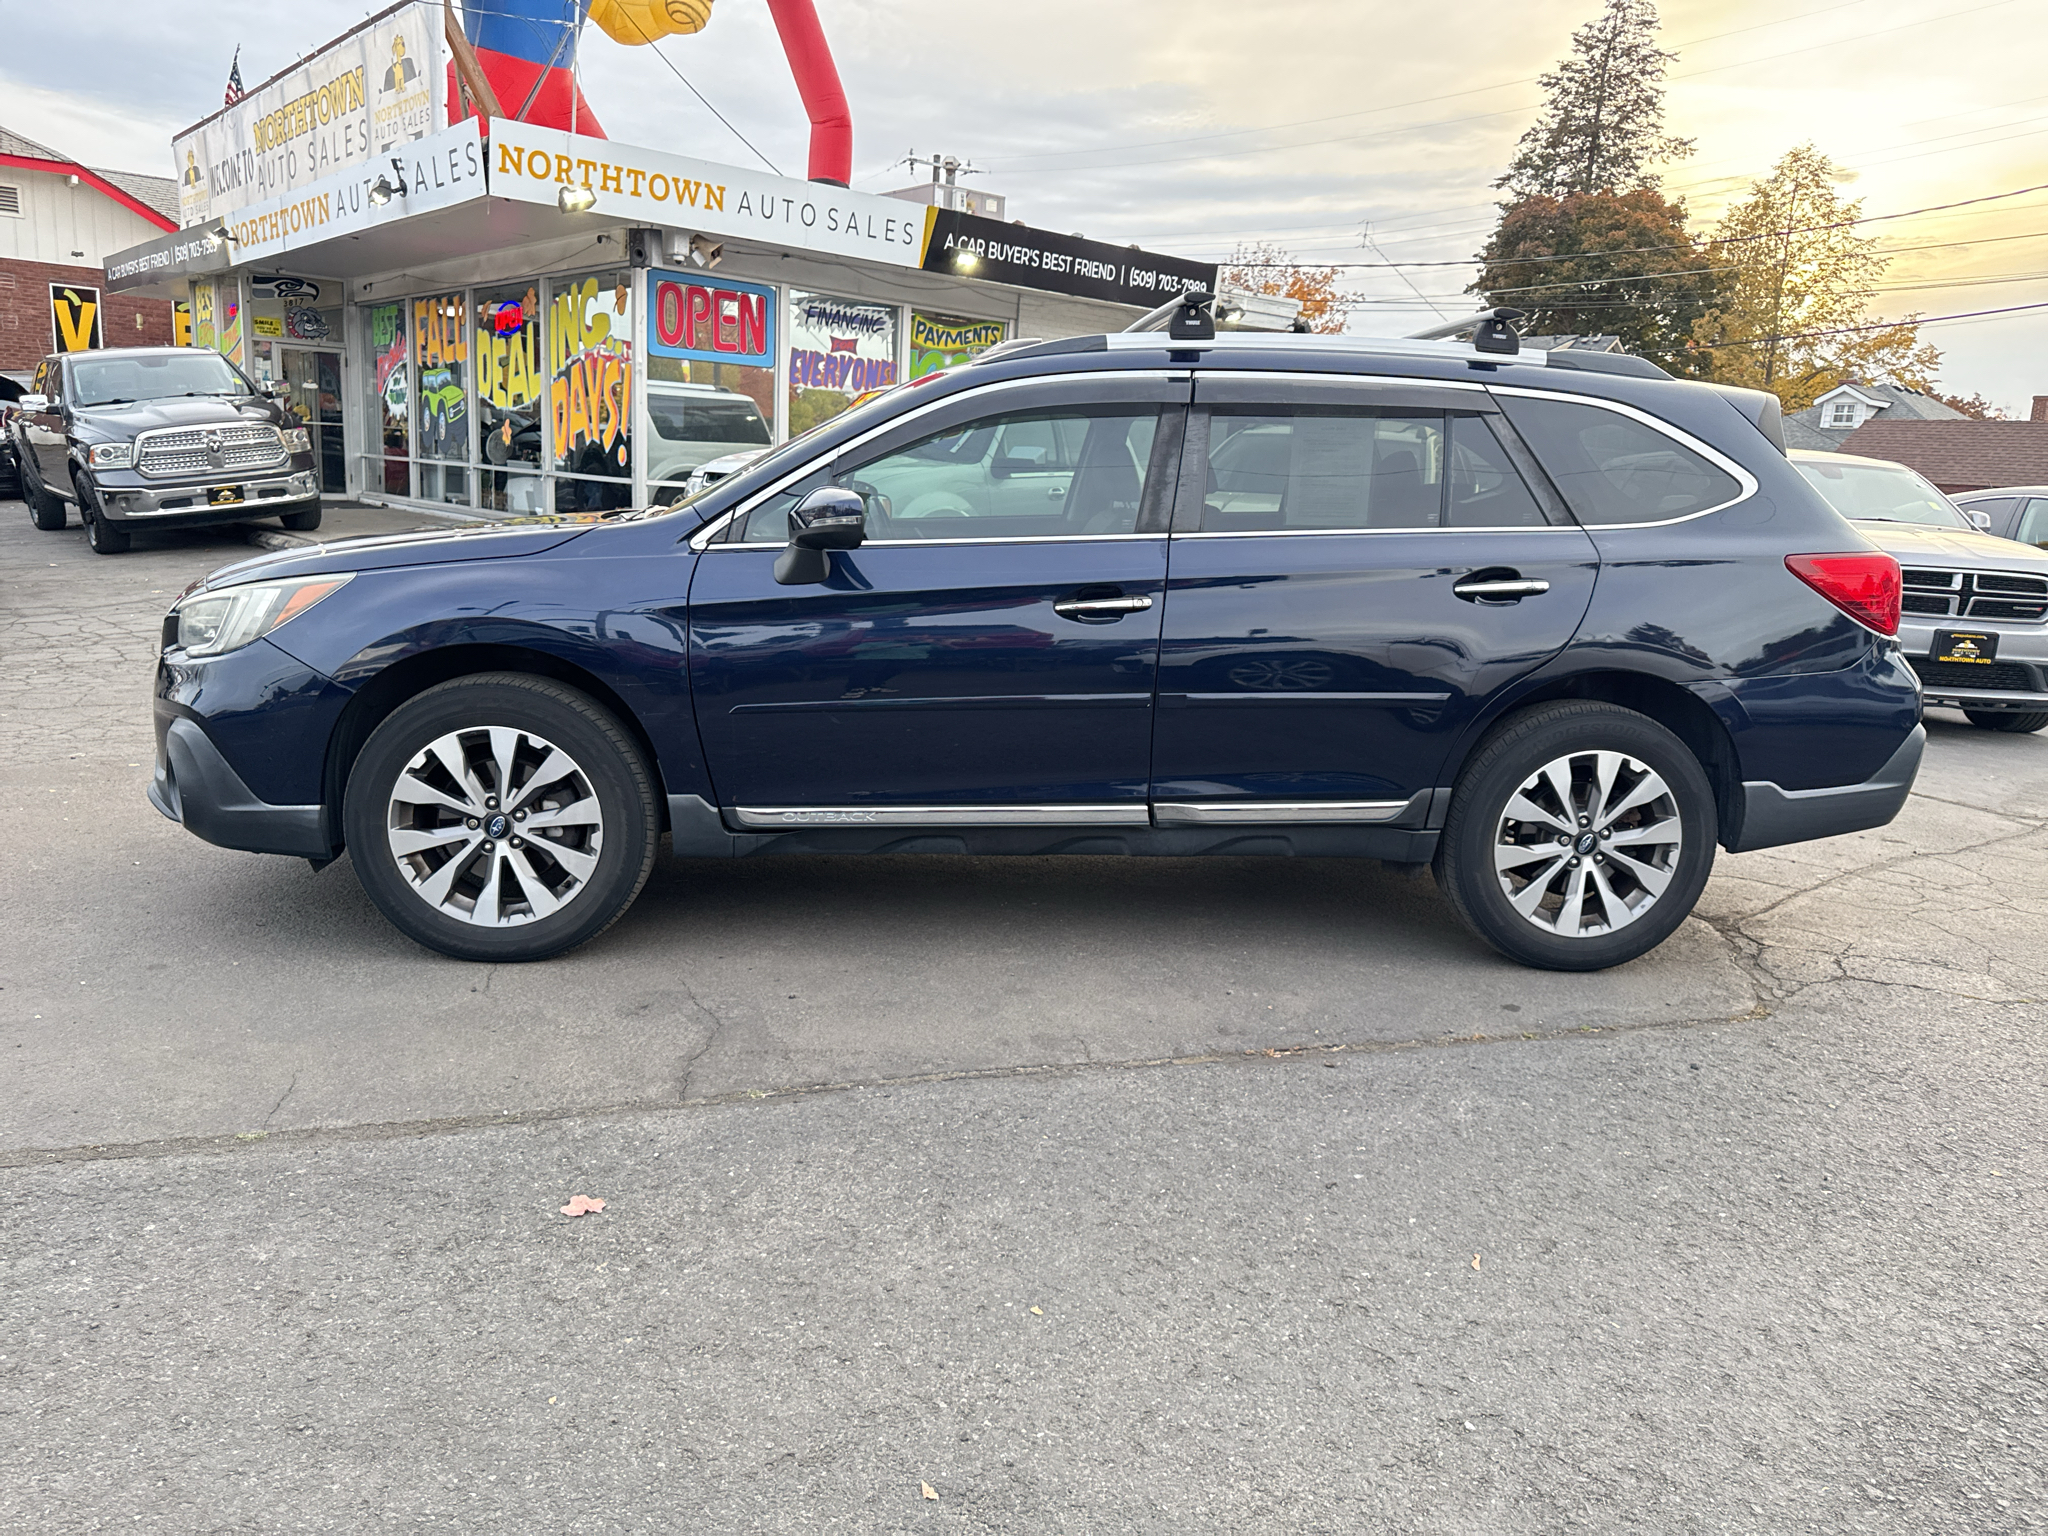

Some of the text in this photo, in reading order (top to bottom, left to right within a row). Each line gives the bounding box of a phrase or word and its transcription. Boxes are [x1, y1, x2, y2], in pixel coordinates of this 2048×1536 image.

[253, 64, 366, 158] NORTHTOWN
[374, 89, 430, 125] NORTHTOWN
[374, 107, 431, 142] AUTO SALES
[242, 146, 254, 185] TO
[258, 118, 368, 193] AUTO SALES
[498, 143, 915, 246] NORTHTOWN AUTO SALES
[231, 192, 330, 251] NORTHTOWN
[943, 232, 1207, 293] A CAR BUYER'S BEST FRIEND (509) 703-7989
[254, 319, 274, 327] SMILE
[283, 298, 304, 308] 3817
[494, 306, 523, 332] OPEN
[656, 281, 766, 355] OPEN
[804, 305, 885, 333] FINANCING
[372, 304, 398, 347] BEST
[414, 295, 467, 368] FALL
[833, 340, 854, 352] FOR
[914, 319, 1000, 347] PAYMENTS
[789, 347, 898, 391] EVERYONE!
[550, 357, 632, 467] DAYS!
[782, 811, 877, 822] OUTBACK
